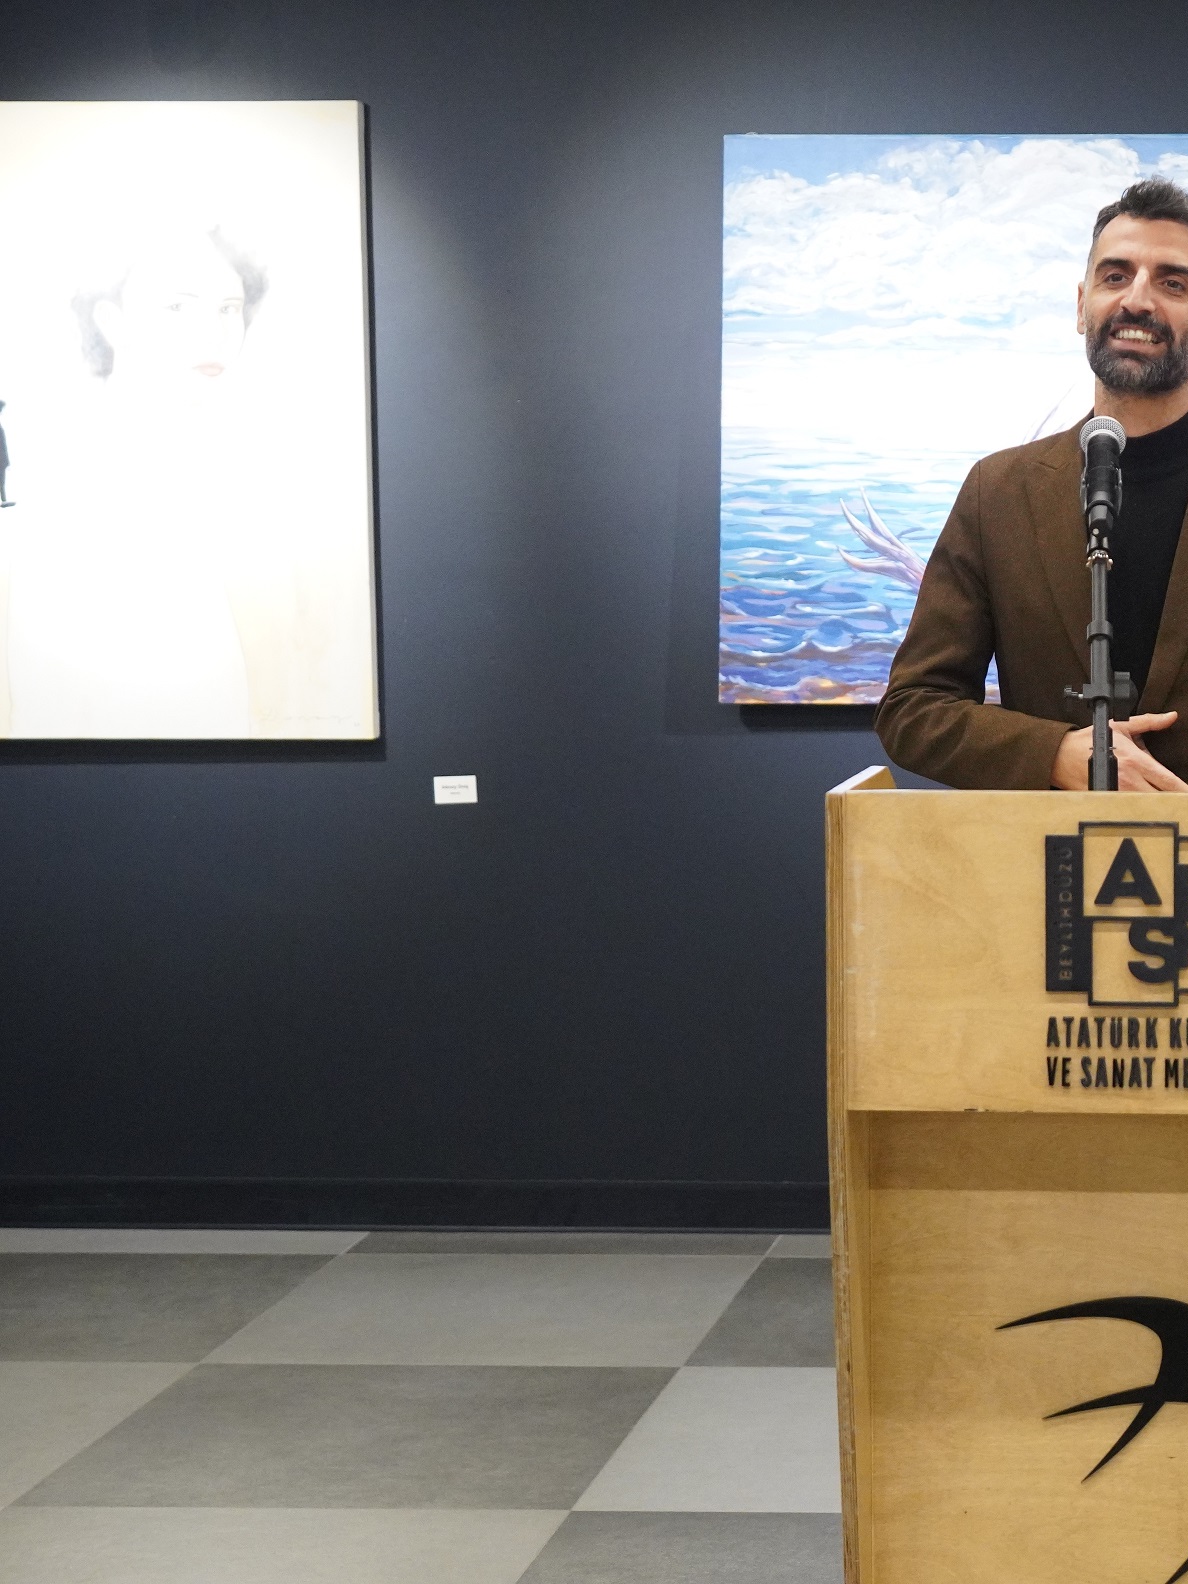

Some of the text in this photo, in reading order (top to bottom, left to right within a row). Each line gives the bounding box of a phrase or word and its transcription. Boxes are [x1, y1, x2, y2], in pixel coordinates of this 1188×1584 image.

[1046, 1015, 1159, 1050] ATATÜRK
[1046, 1056, 1072, 1089] VE
[1080, 1056, 1156, 1090] SANAT
